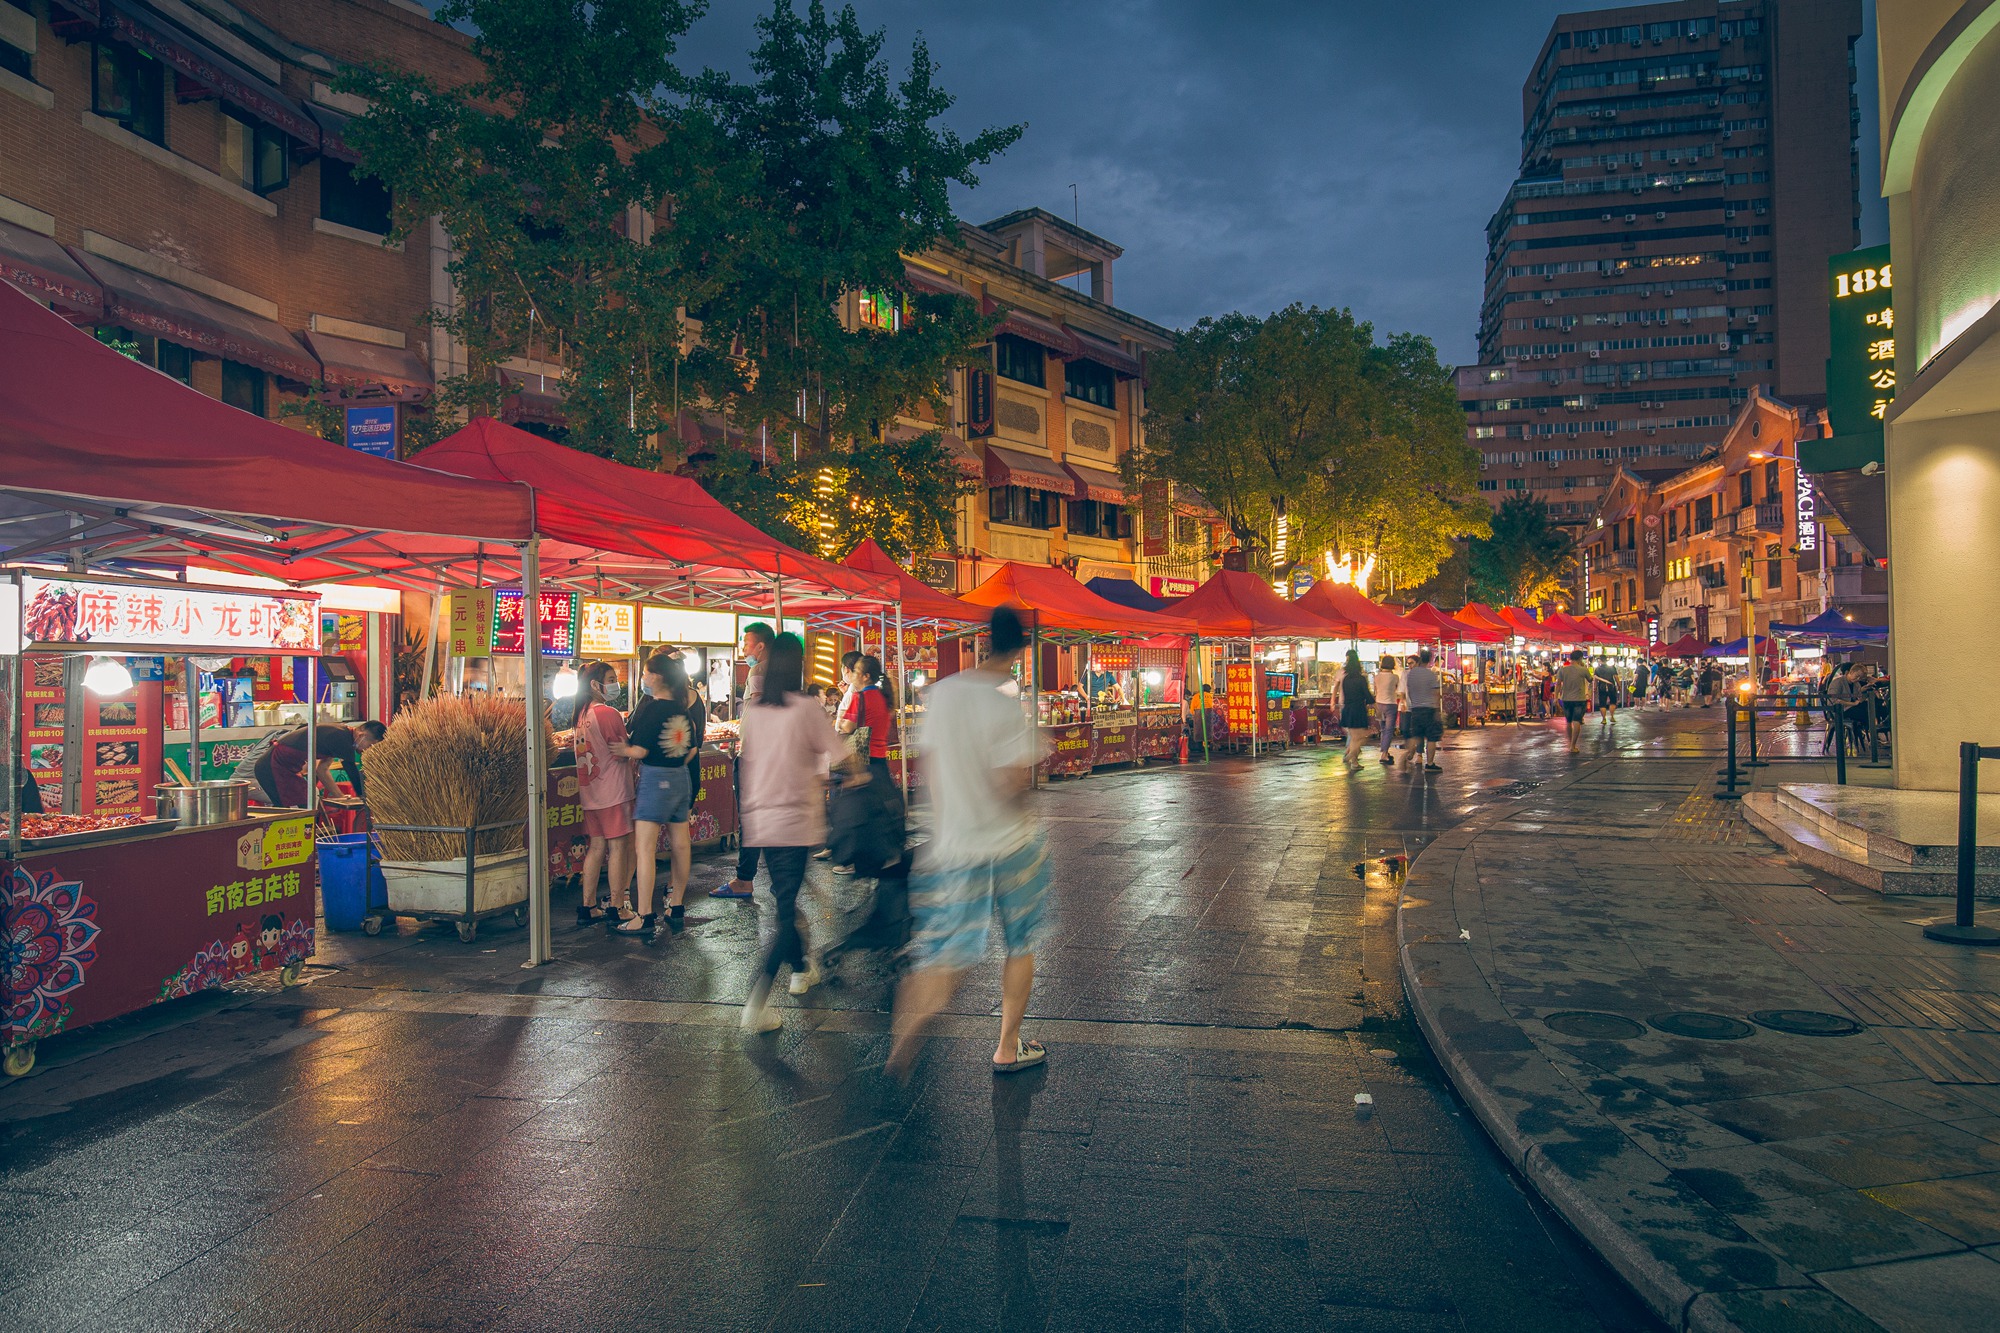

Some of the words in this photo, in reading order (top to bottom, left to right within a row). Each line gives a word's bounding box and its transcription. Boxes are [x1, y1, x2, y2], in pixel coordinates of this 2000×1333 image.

[77, 589, 279, 638] 麻辣小龙虾
[455, 595, 467, 654] 一元一串
[476, 600, 485, 647] 铁板鱿鱼
[865, 629, 935, 646] 御品猪蹄
[206, 870, 300, 917] 宵夜吉庆街
